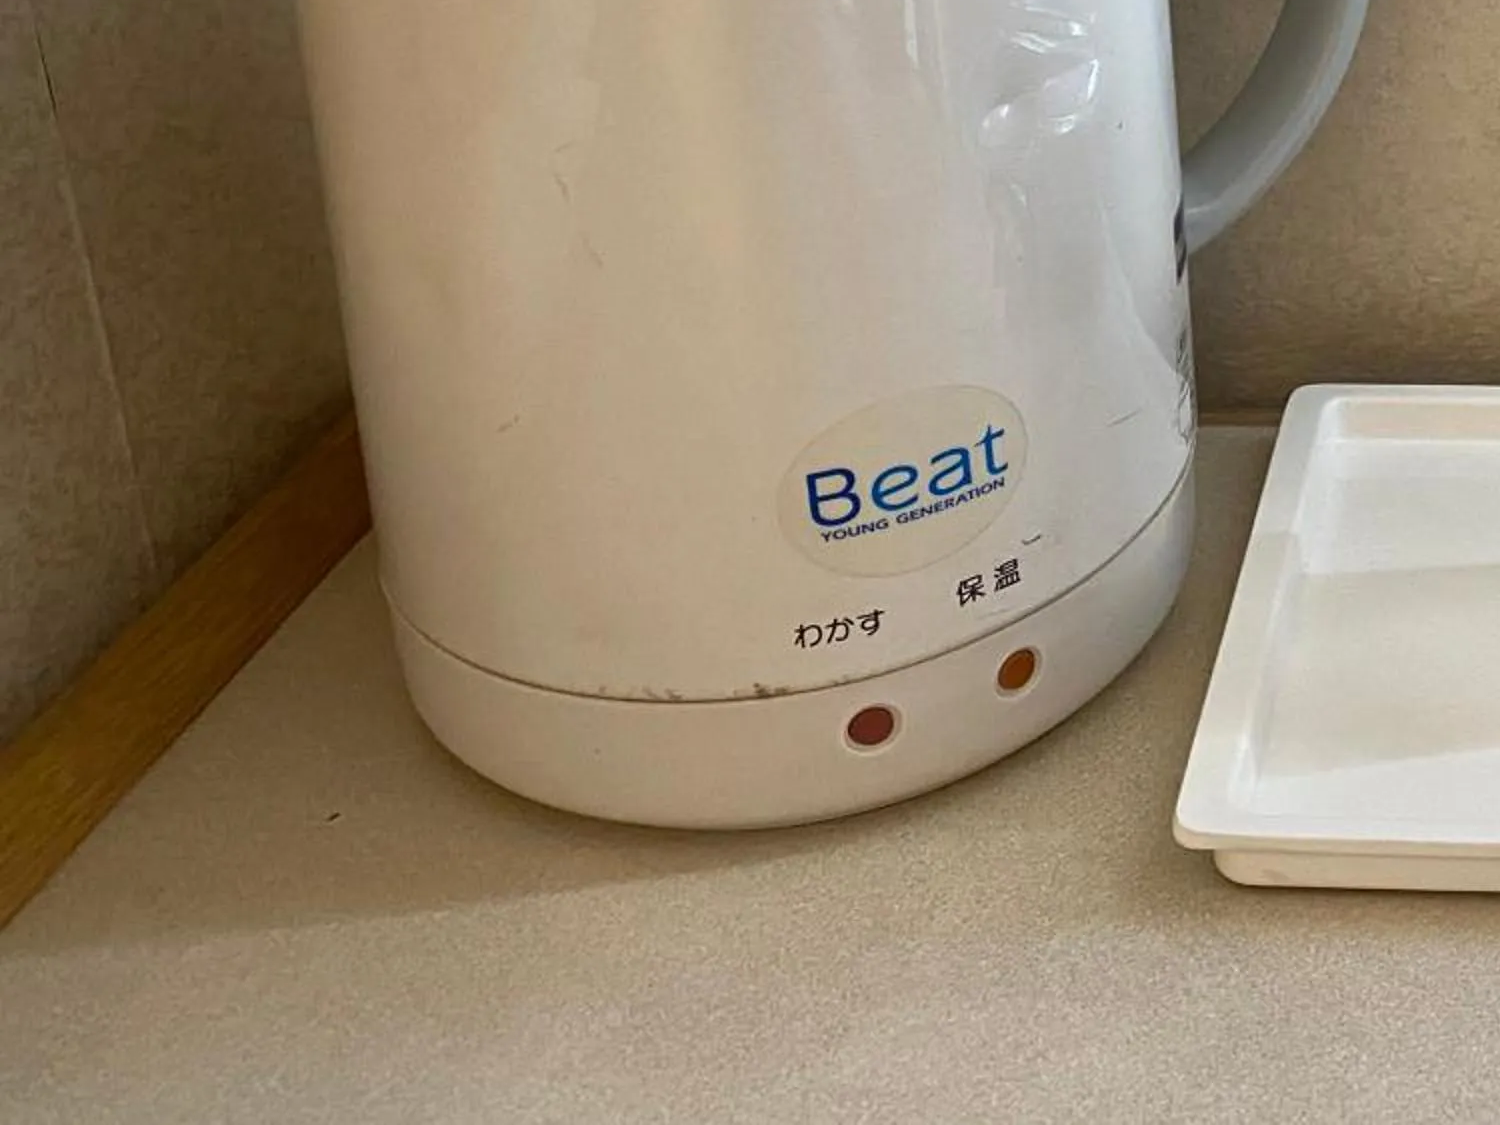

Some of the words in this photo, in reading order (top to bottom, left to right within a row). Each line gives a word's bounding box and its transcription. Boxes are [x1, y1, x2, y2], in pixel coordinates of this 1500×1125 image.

[805, 423, 1009, 527] Beat
[820, 517, 890, 543] YOUNG
[895, 476, 1006, 525] GENERATION
[956, 558, 1022, 607] 保温
[793, 608, 886, 649] わかす
